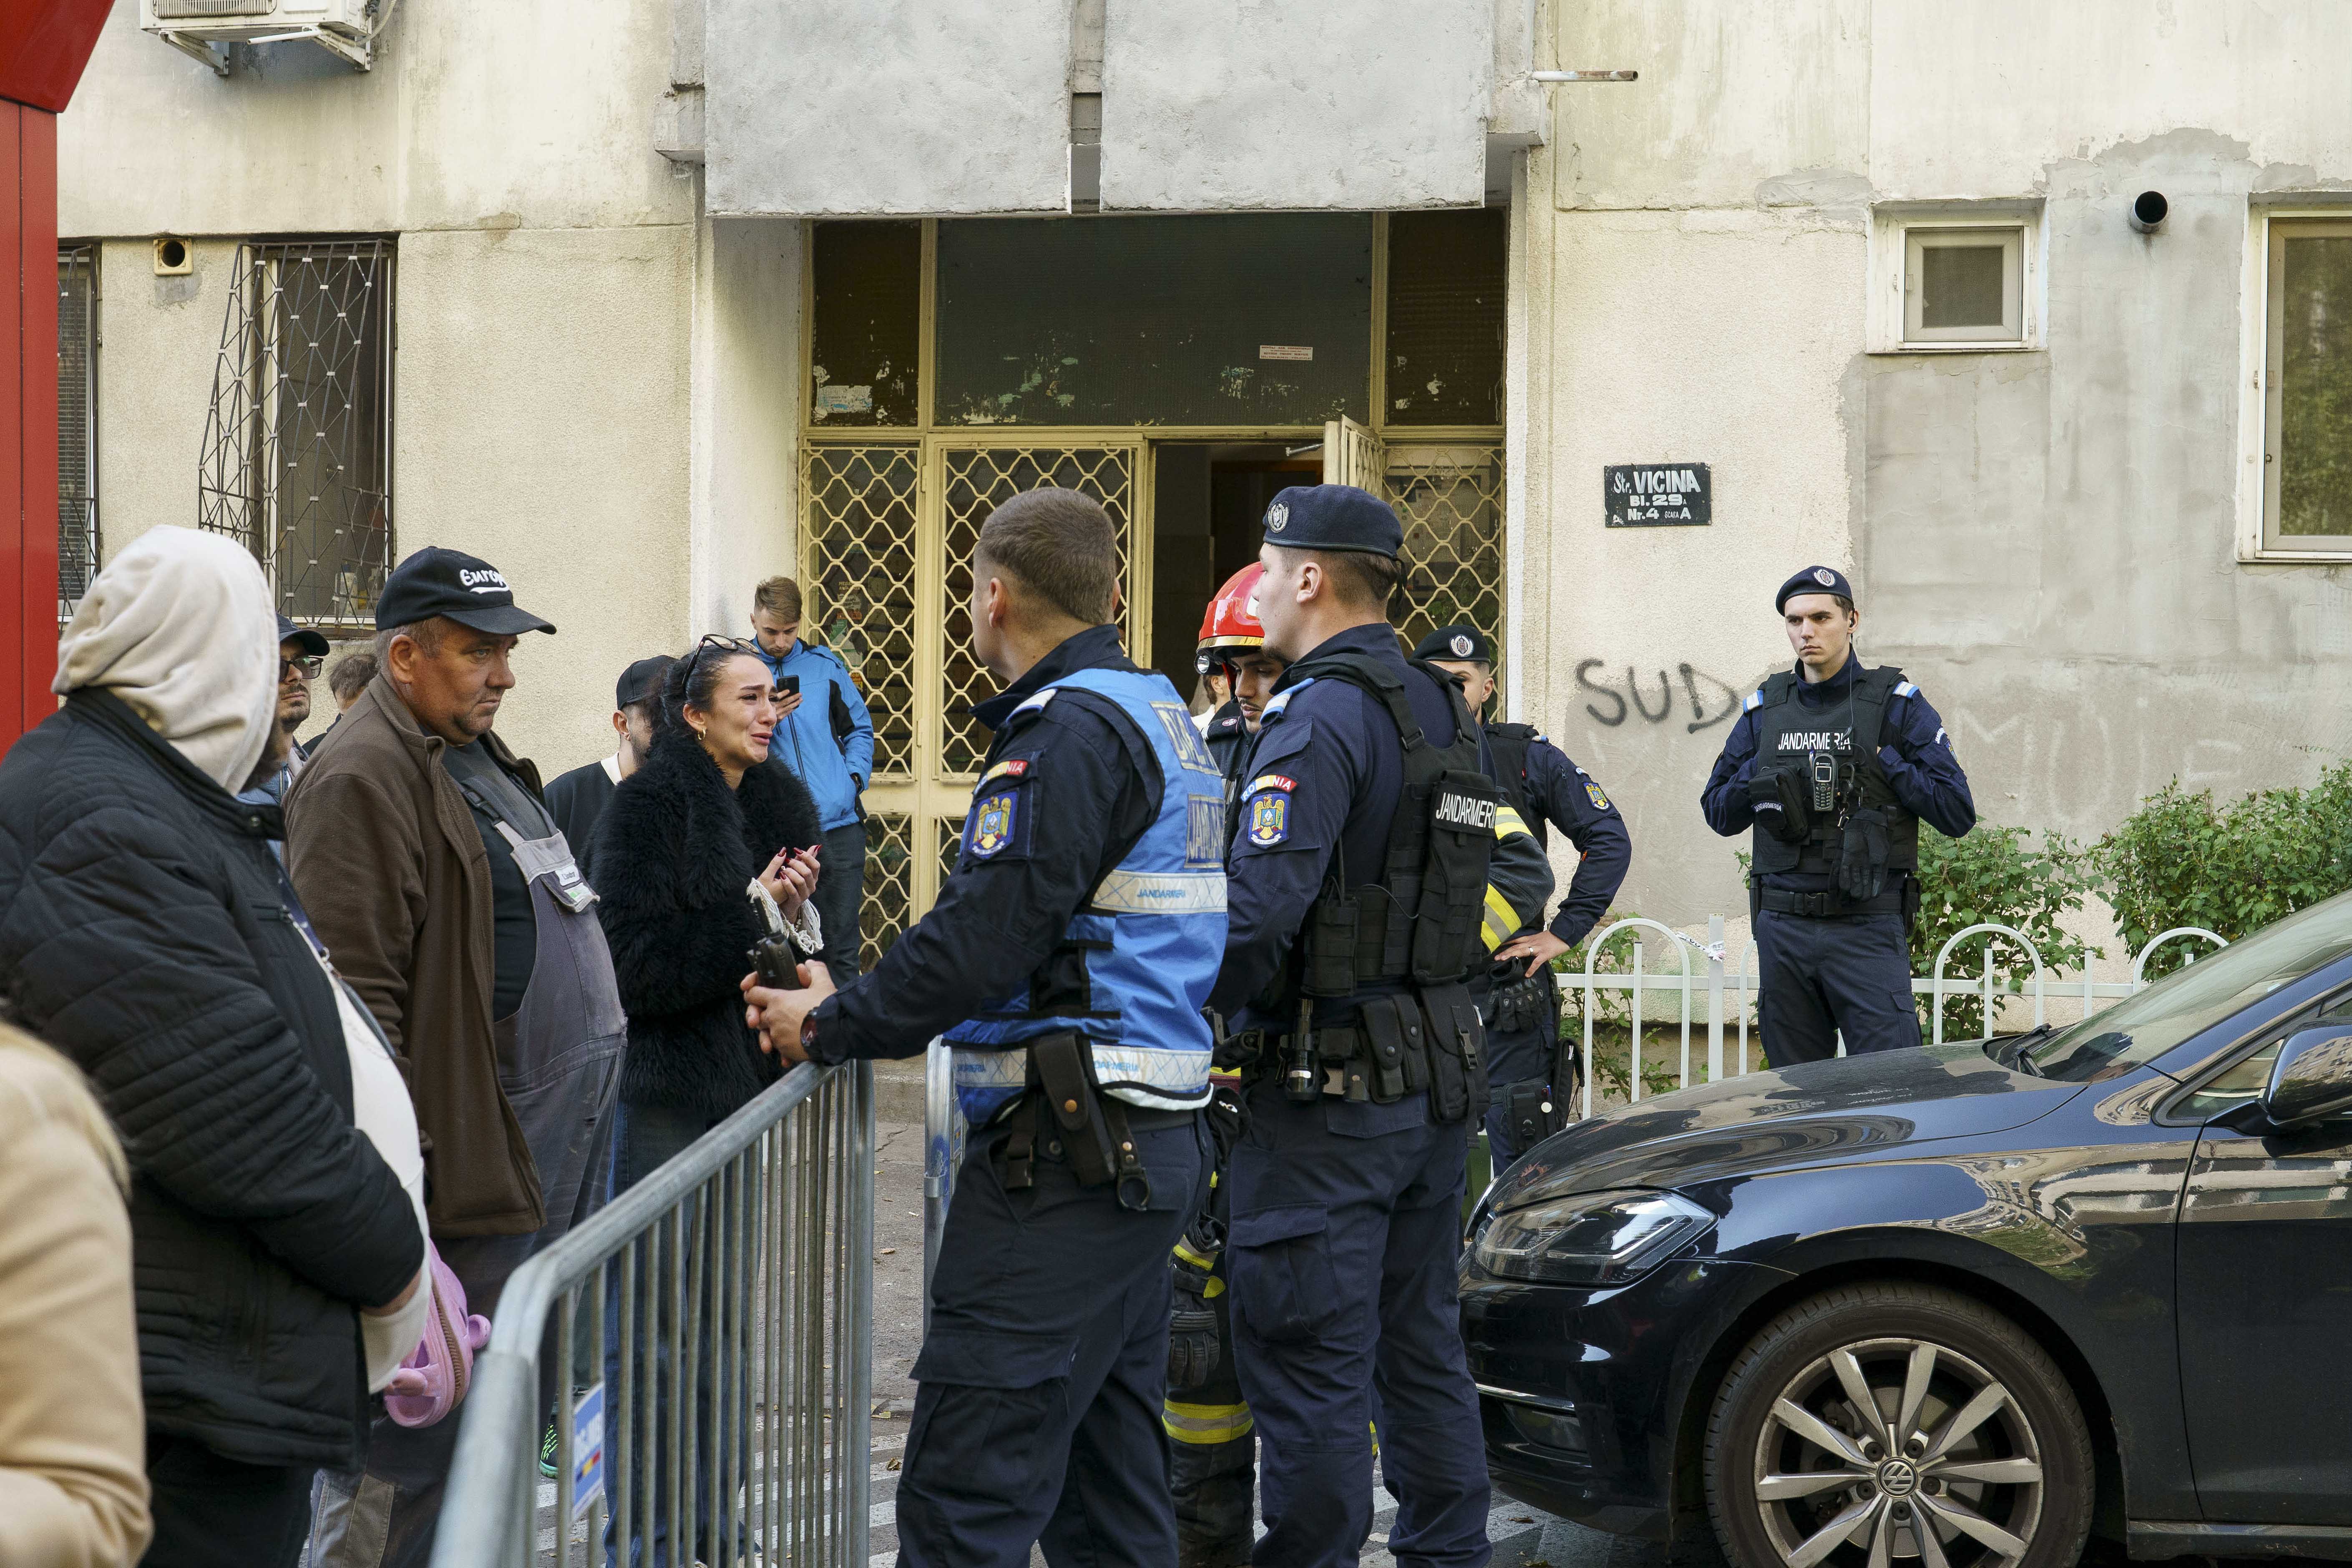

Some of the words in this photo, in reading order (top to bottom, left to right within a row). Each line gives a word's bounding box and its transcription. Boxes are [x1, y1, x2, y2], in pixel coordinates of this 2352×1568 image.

[1613, 472, 1632, 494] Str.
[1633, 470, 1701, 493] VICINA
[1630, 495, 1650, 506] Bl.
[1680, 507, 1691, 519] A
[1576, 658, 1740, 734] SUD
[1754, 802, 1781, 812] JANDARMERIA
